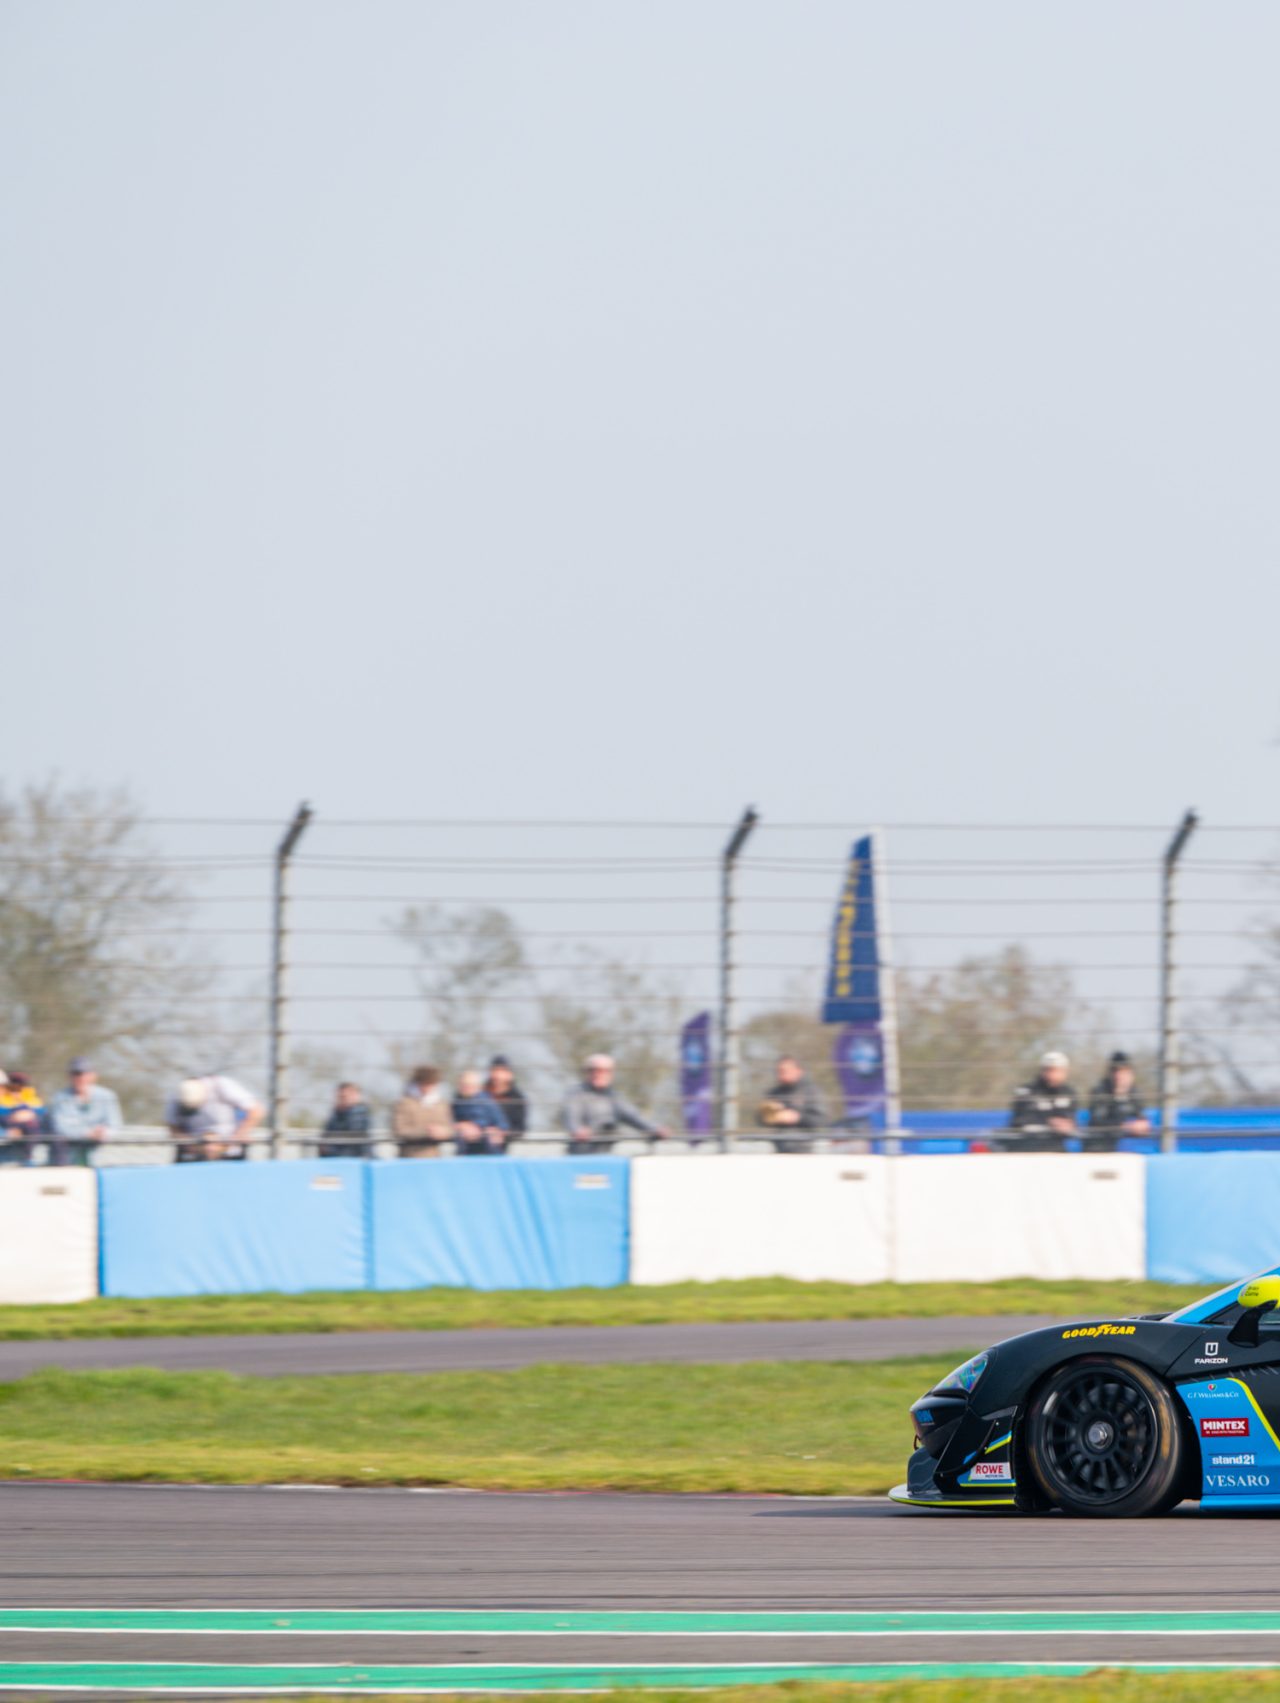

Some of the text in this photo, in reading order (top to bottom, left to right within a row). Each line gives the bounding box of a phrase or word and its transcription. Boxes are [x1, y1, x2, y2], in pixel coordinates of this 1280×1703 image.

[1061, 1323, 1137, 1340] GOODYEAR
[1194, 1356, 1229, 1365] FARIZON
[1202, 1420, 1246, 1431] MINTEX
[975, 1465, 1004, 1475] ROWE
[1206, 1475, 1270, 1487] VESARO
